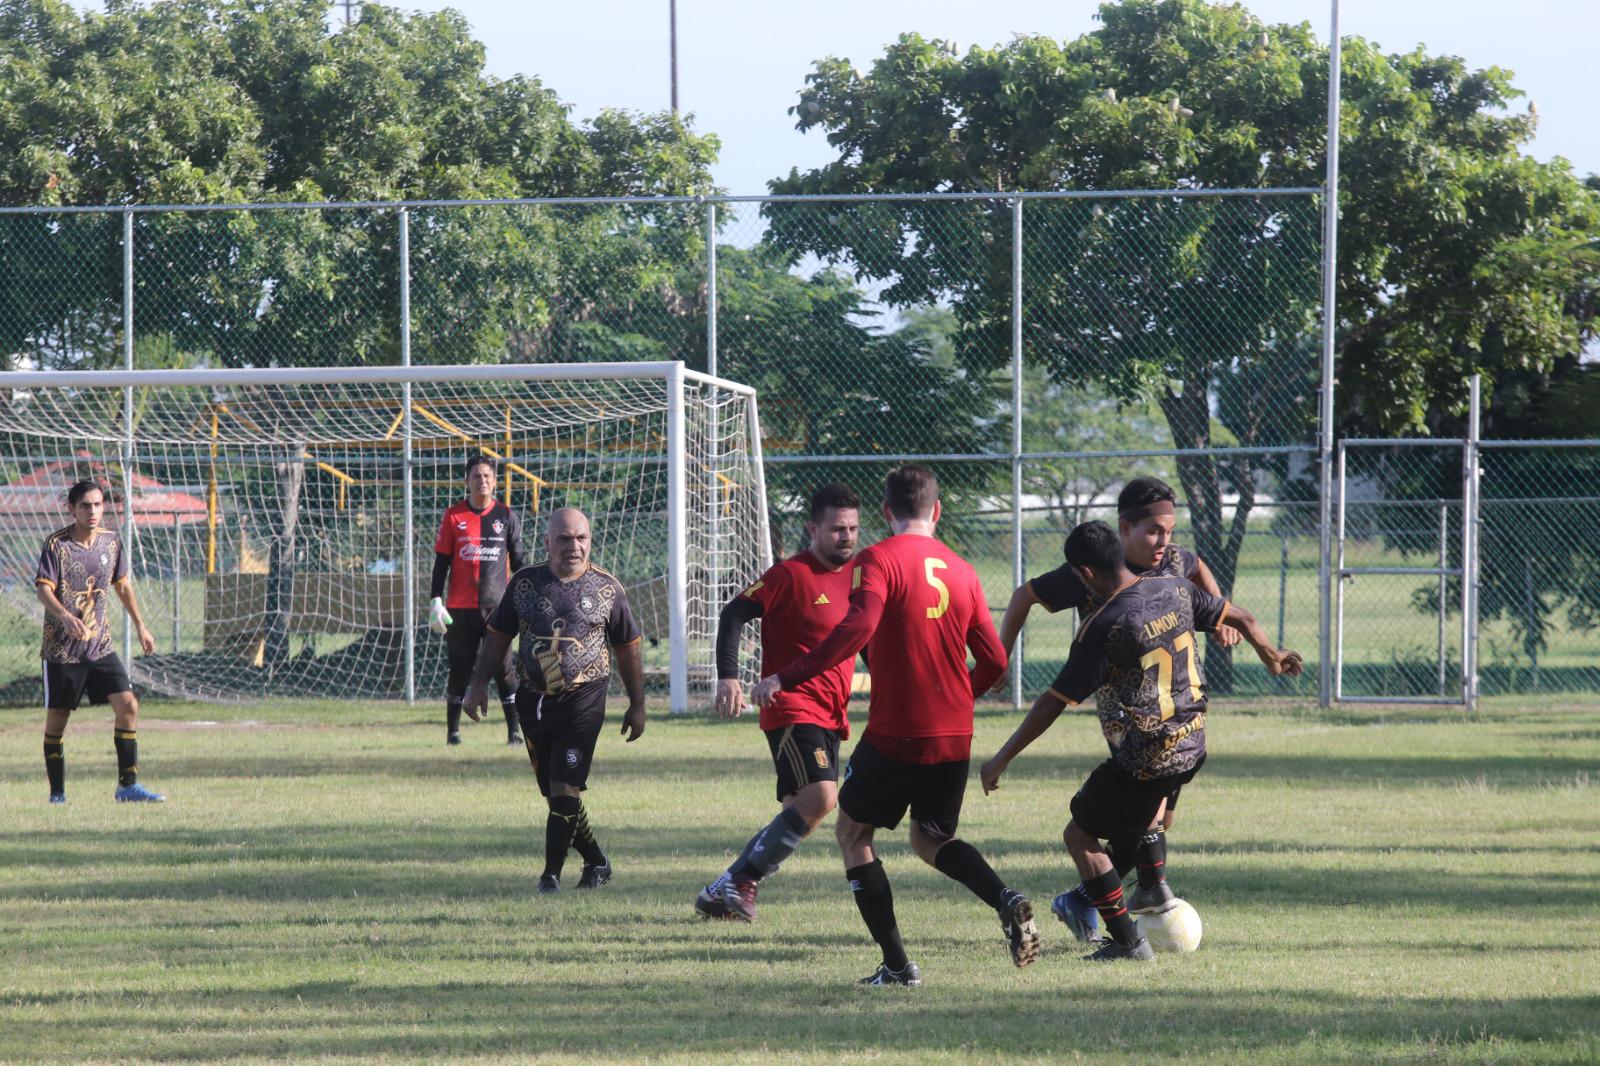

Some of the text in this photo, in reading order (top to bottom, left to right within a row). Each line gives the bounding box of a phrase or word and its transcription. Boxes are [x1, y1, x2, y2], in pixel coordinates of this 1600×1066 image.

[924, 557, 949, 618] 5
[1144, 611, 1179, 639] LIMON
[1140, 630, 1203, 721] 77
